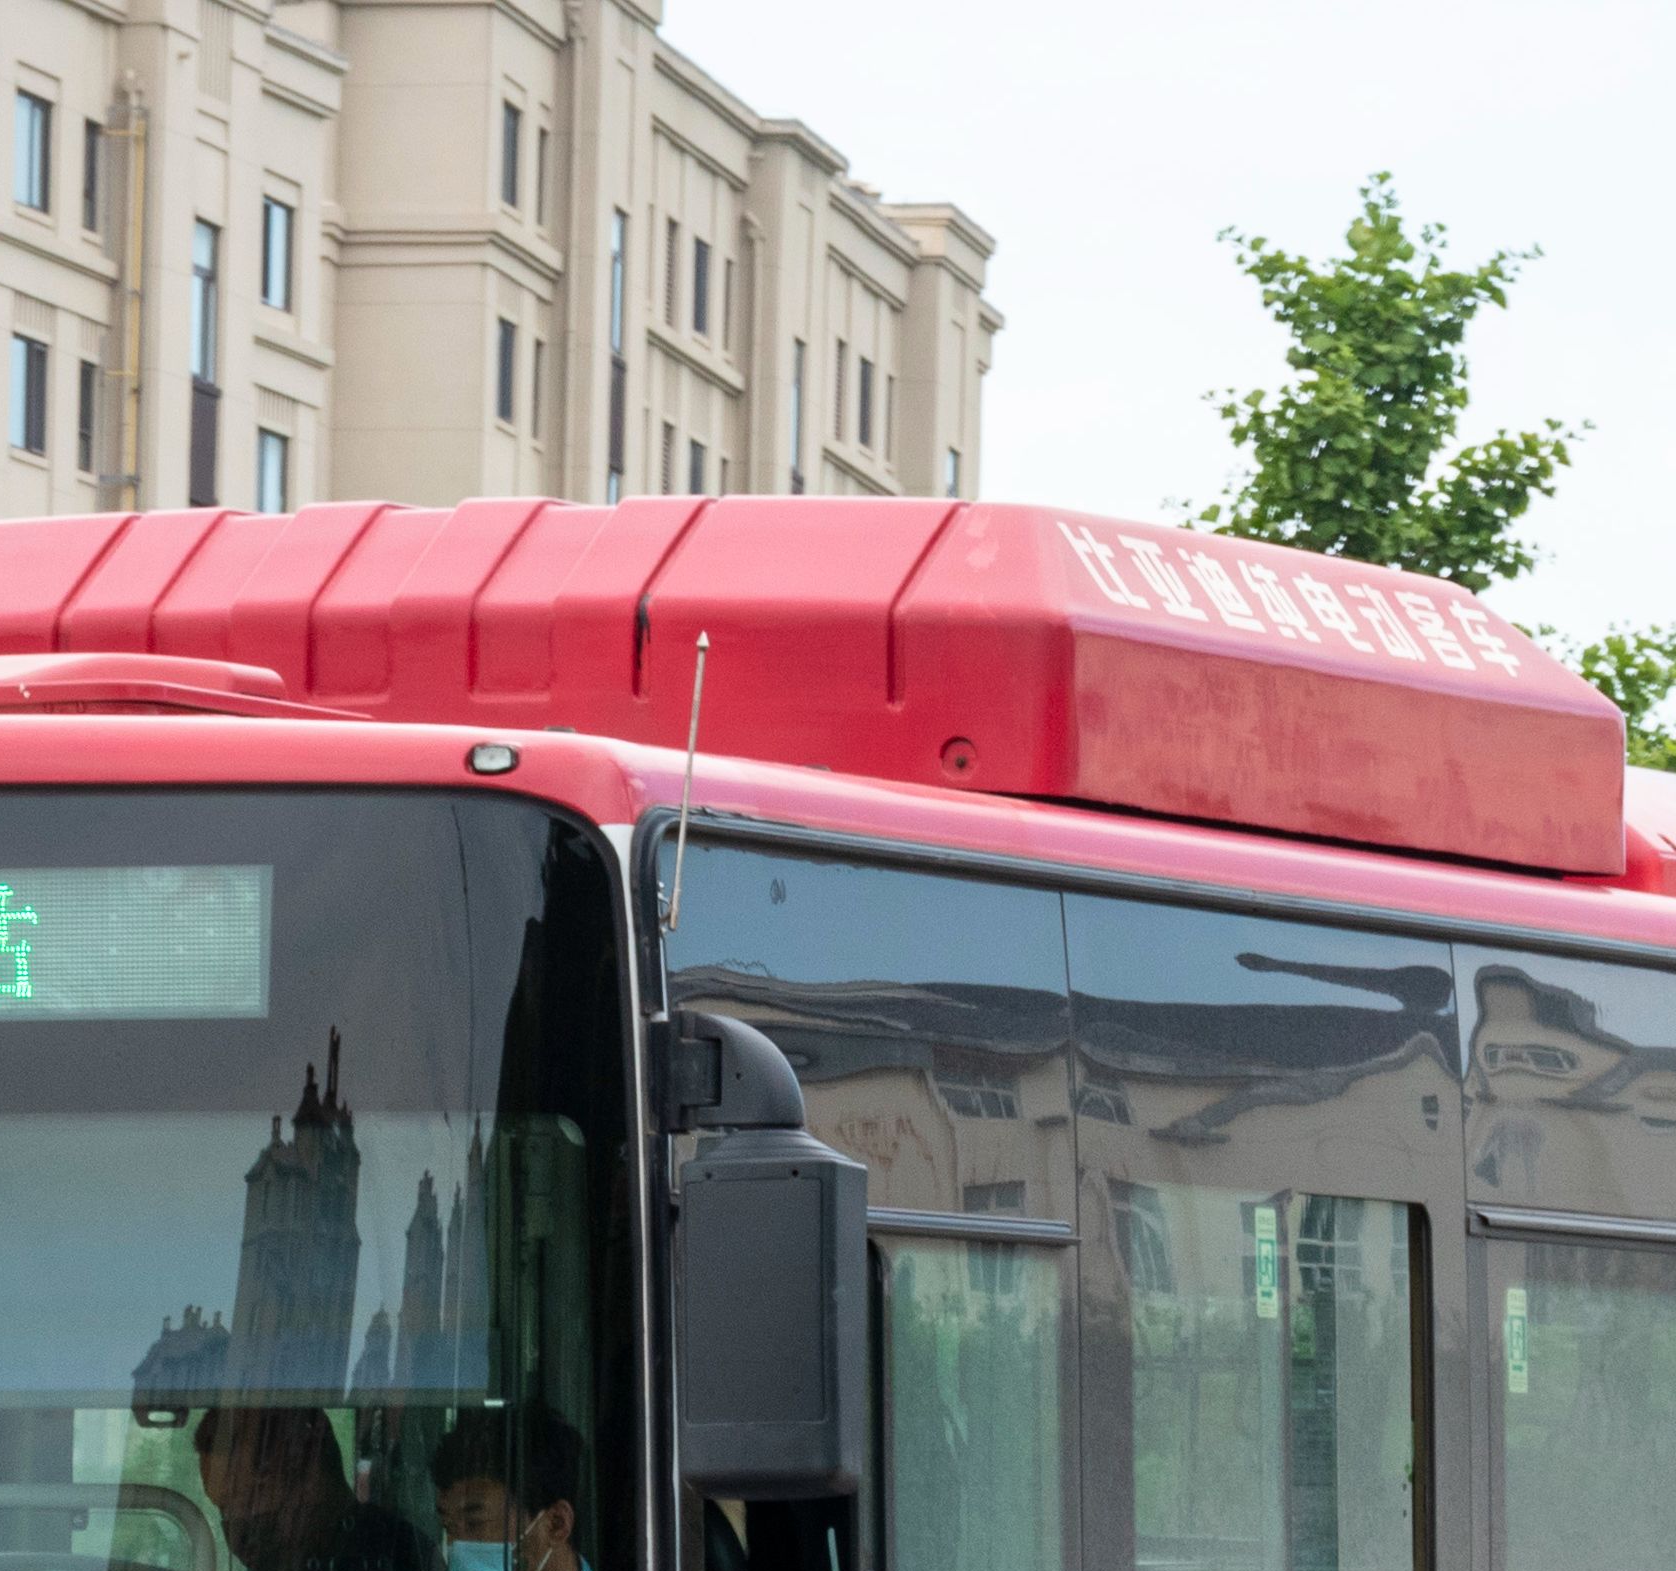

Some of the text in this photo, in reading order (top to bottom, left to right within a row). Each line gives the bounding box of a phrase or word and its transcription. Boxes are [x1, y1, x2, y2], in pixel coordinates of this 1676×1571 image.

[1057, 522, 1520, 677] 比亚迪纯电动客车
